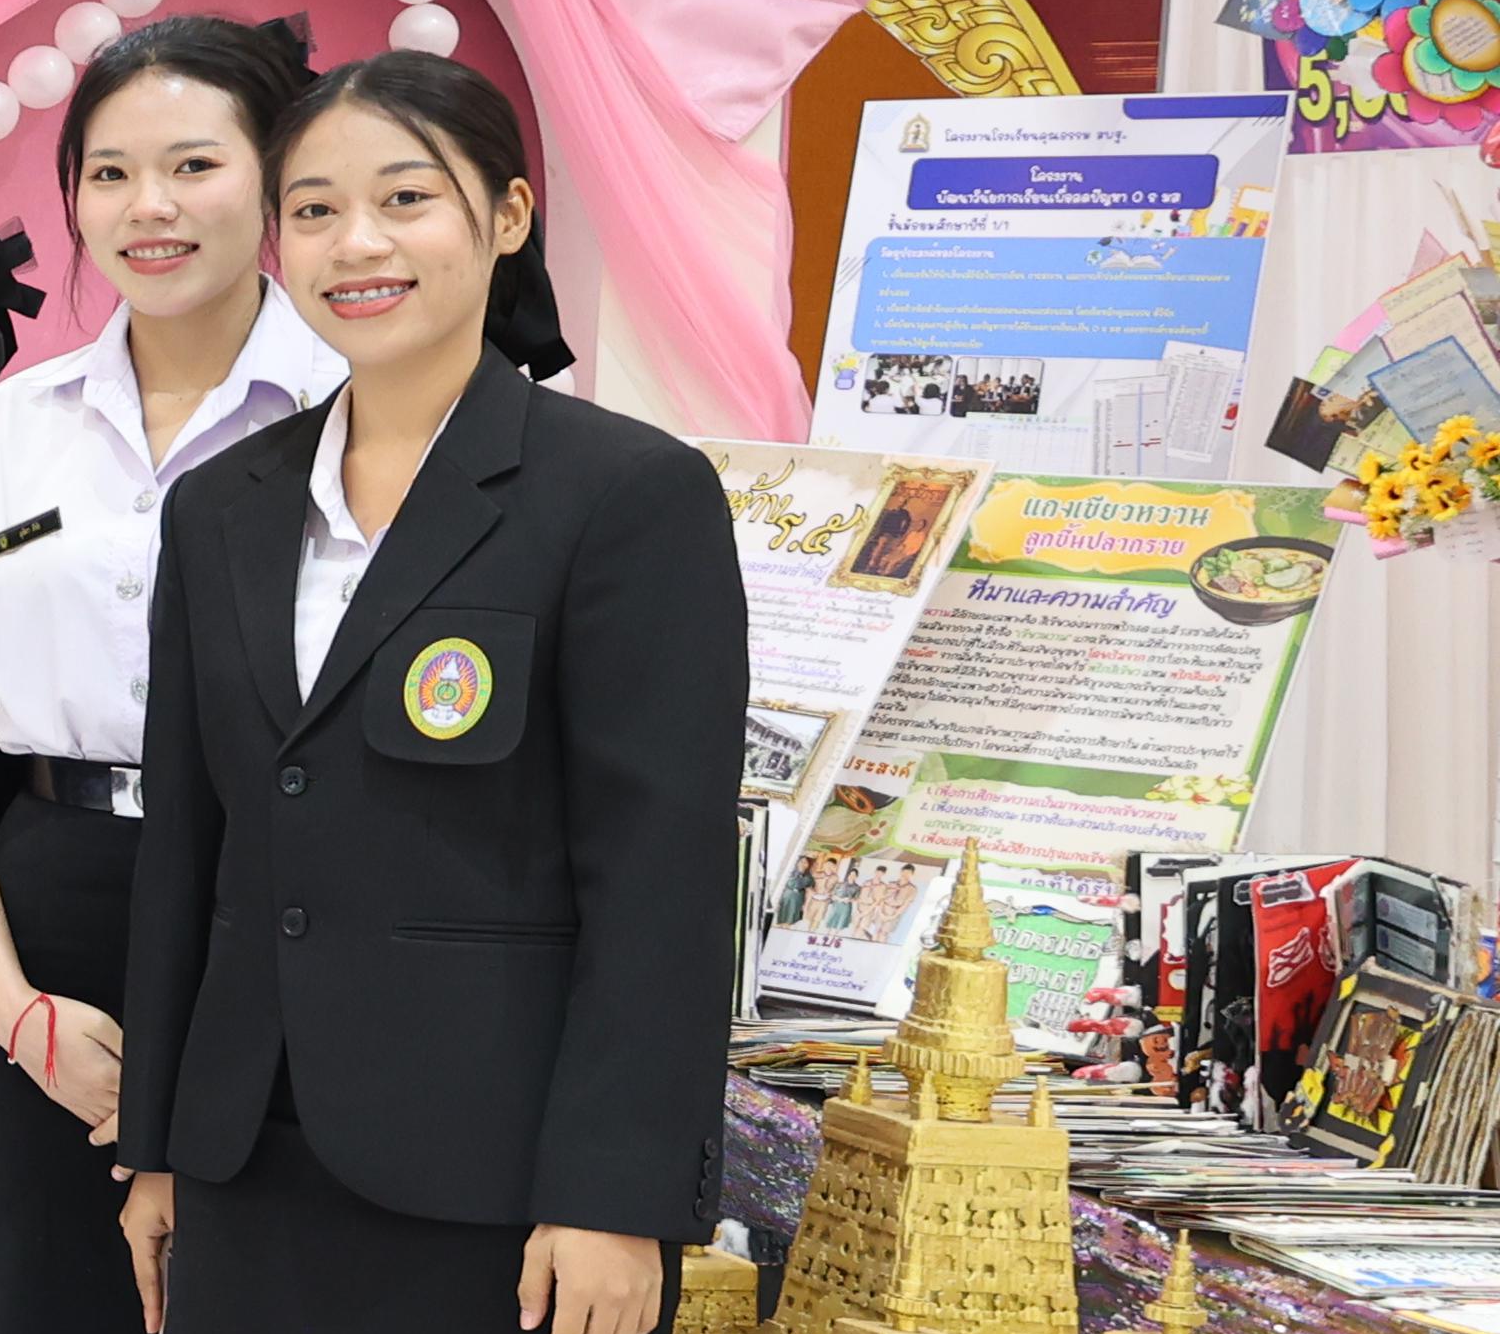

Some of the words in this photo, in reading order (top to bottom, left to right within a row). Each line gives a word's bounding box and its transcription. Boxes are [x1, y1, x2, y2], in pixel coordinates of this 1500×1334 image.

[1029, 165, 1083, 183] โครงงาน
[888, 213, 988, 232] ชั้นมัธยมศึกษาปีที่
[992, 220, 1010, 231] 1/1
[1023, 496, 1209, 527] แกงเขียวหวาน
[1023, 523, 1186, 556] ลูกชิ้นปลากราย
[967, 574, 1177, 618] ที่มาและความสำคัญ
